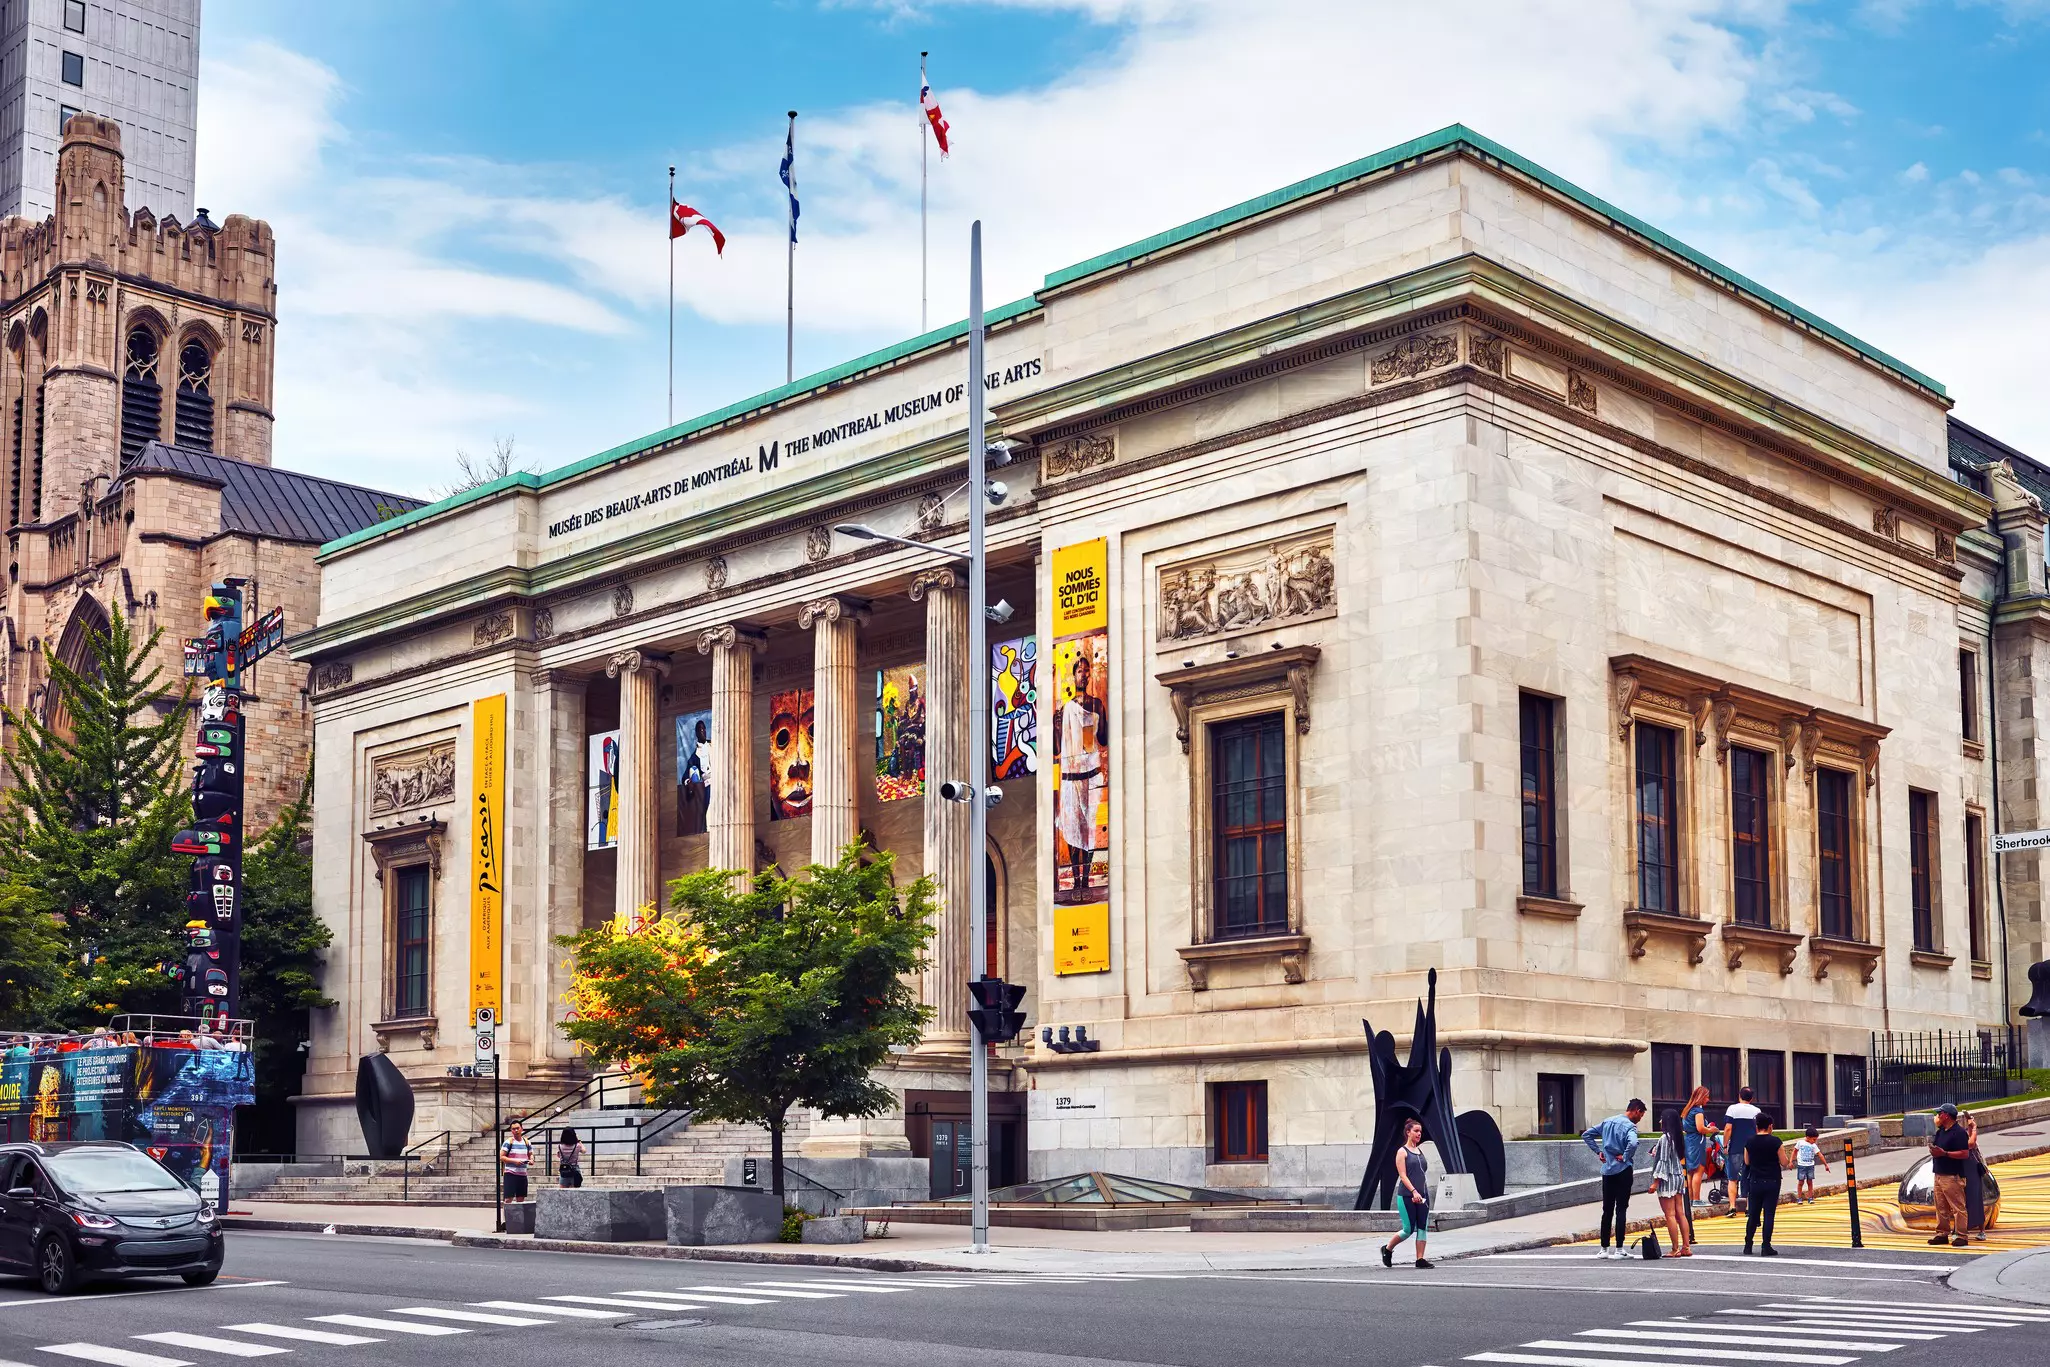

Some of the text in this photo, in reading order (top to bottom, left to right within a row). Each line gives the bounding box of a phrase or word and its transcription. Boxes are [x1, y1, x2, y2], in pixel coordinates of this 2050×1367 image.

[548, 514, 582, 539] MUSÉE
[584, 507, 604, 526] DES
[605, 484, 671, 519] BEAUX-ARTS
[674, 478, 688, 496] DE
[691, 457, 753, 490] MONTRÉAL
[759, 440, 778, 473] M
[785, 437, 810, 457] THE
[812, 413, 881, 449] MONTREAL
[884, 391, 942, 425] MUSEUM
[945, 384, 964, 403] OF
[1003, 358, 1041, 385] ARTS
[1066, 567, 1094, 583] NOUS
[1058, 577, 1101, 597] SOMMES
[1061, 591, 1098, 609] ICI, D'ICI
[106, 1054, 127, 1064] PARCOURS
[82, 1066, 108, 1076] PROJECTIONS
[106, 1074, 121, 1084] MONDE
[1056, 1097, 1071, 1105] 1379
